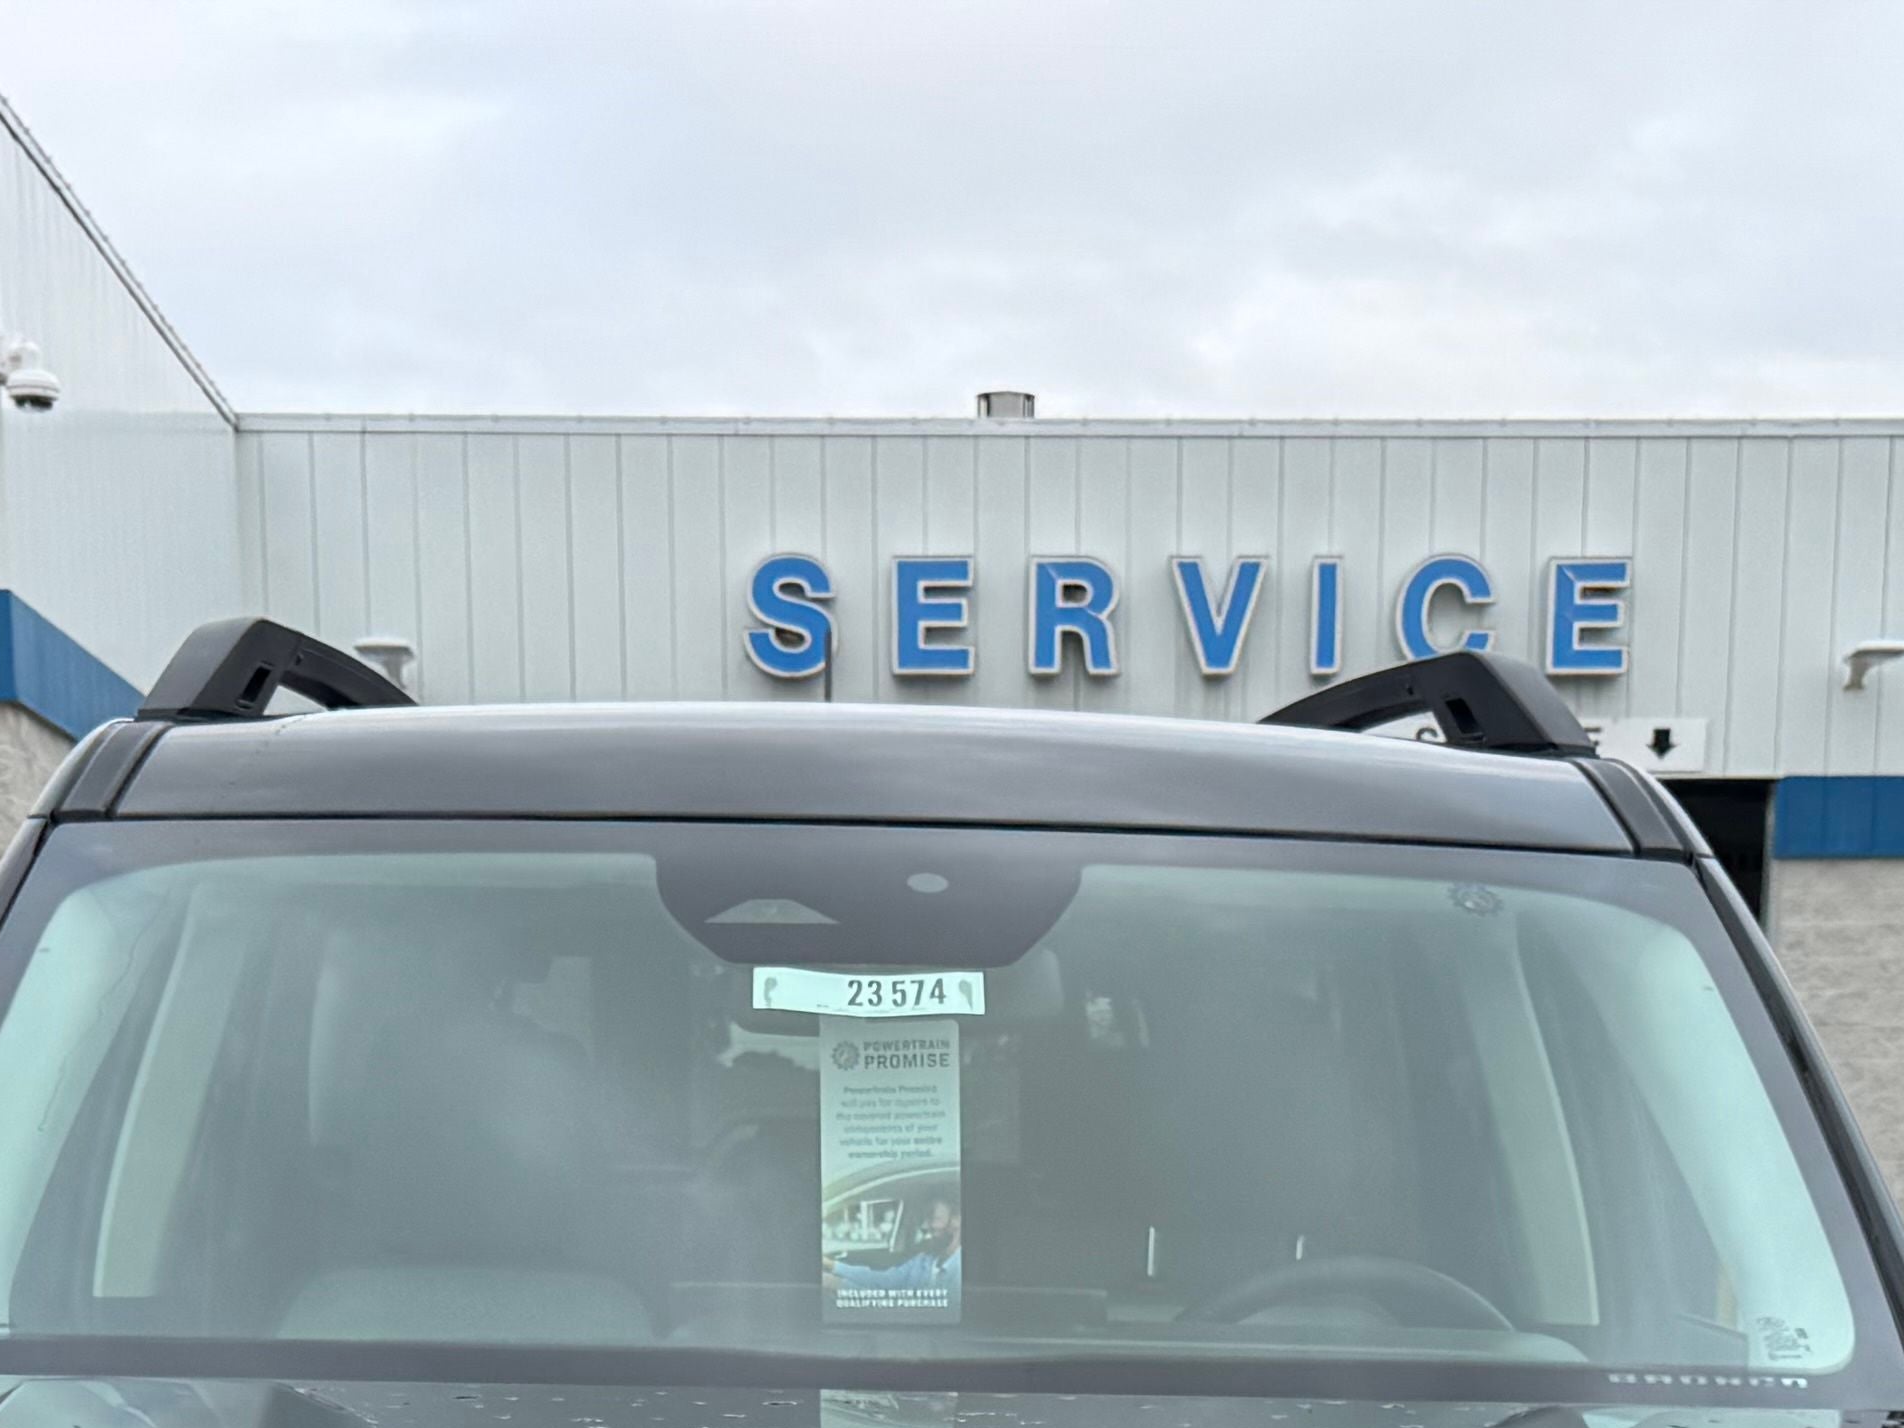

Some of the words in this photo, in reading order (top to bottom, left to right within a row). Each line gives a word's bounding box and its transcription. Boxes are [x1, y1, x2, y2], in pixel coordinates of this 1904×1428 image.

[743, 553, 1631, 678] SERVICE
[863, 1039, 950, 1053] POWERTRAIN
[864, 1053, 950, 1069] PROMISE
[837, 1289, 887, 1298] INCLUDED
